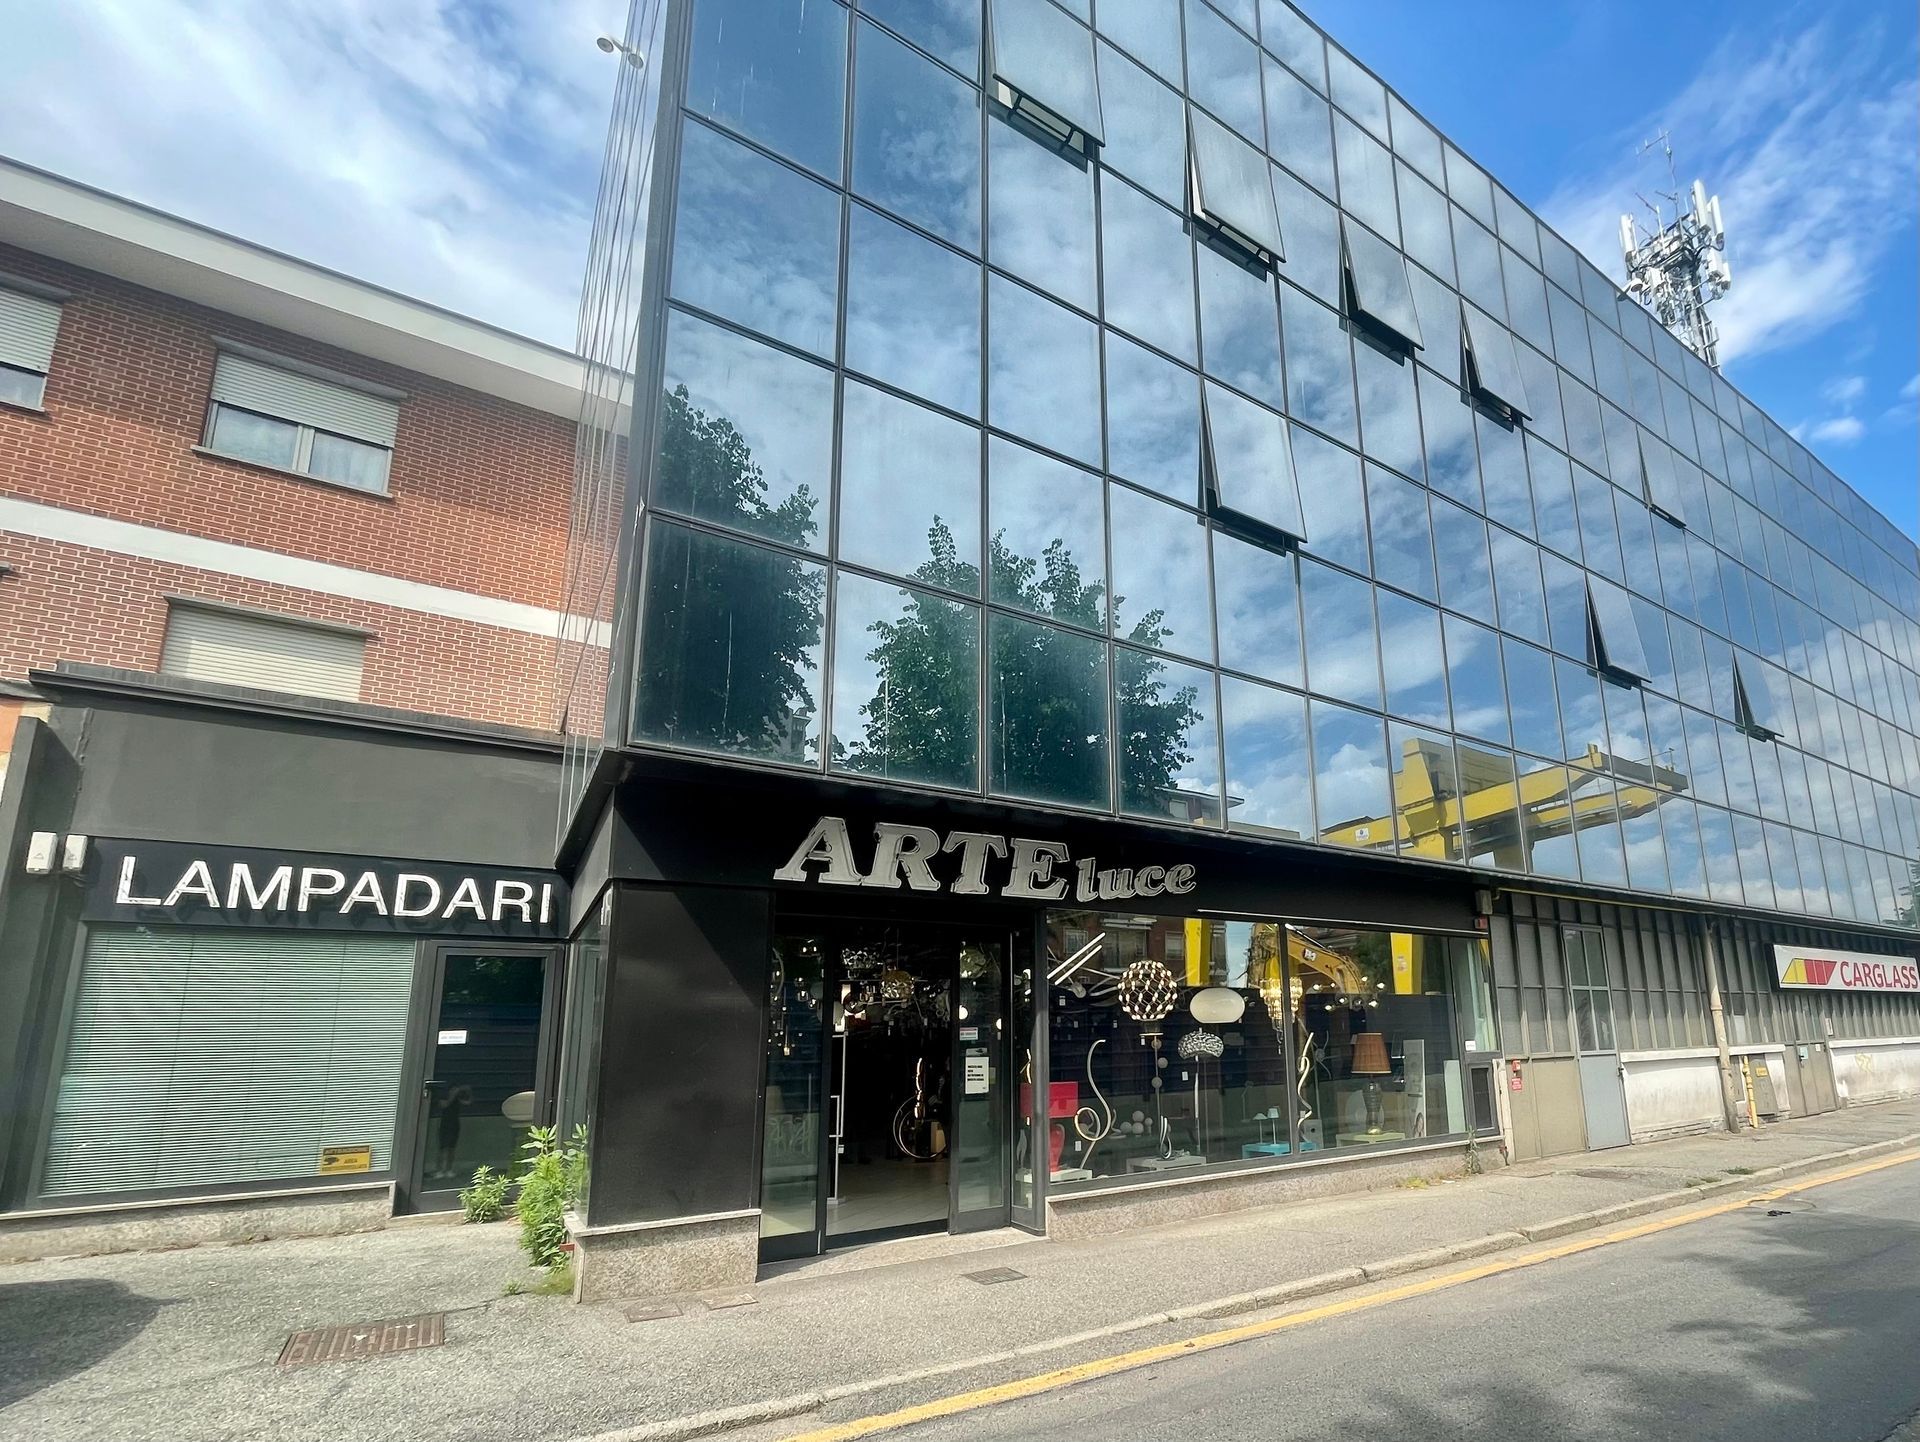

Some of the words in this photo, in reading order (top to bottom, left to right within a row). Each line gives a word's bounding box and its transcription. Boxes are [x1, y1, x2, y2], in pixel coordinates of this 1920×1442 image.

[115, 856, 552, 924] LAMPADARI
[773, 816, 1070, 899] ARTE
[1077, 857, 1197, 902] luce
[1840, 961, 1918, 989] CARGLASS
